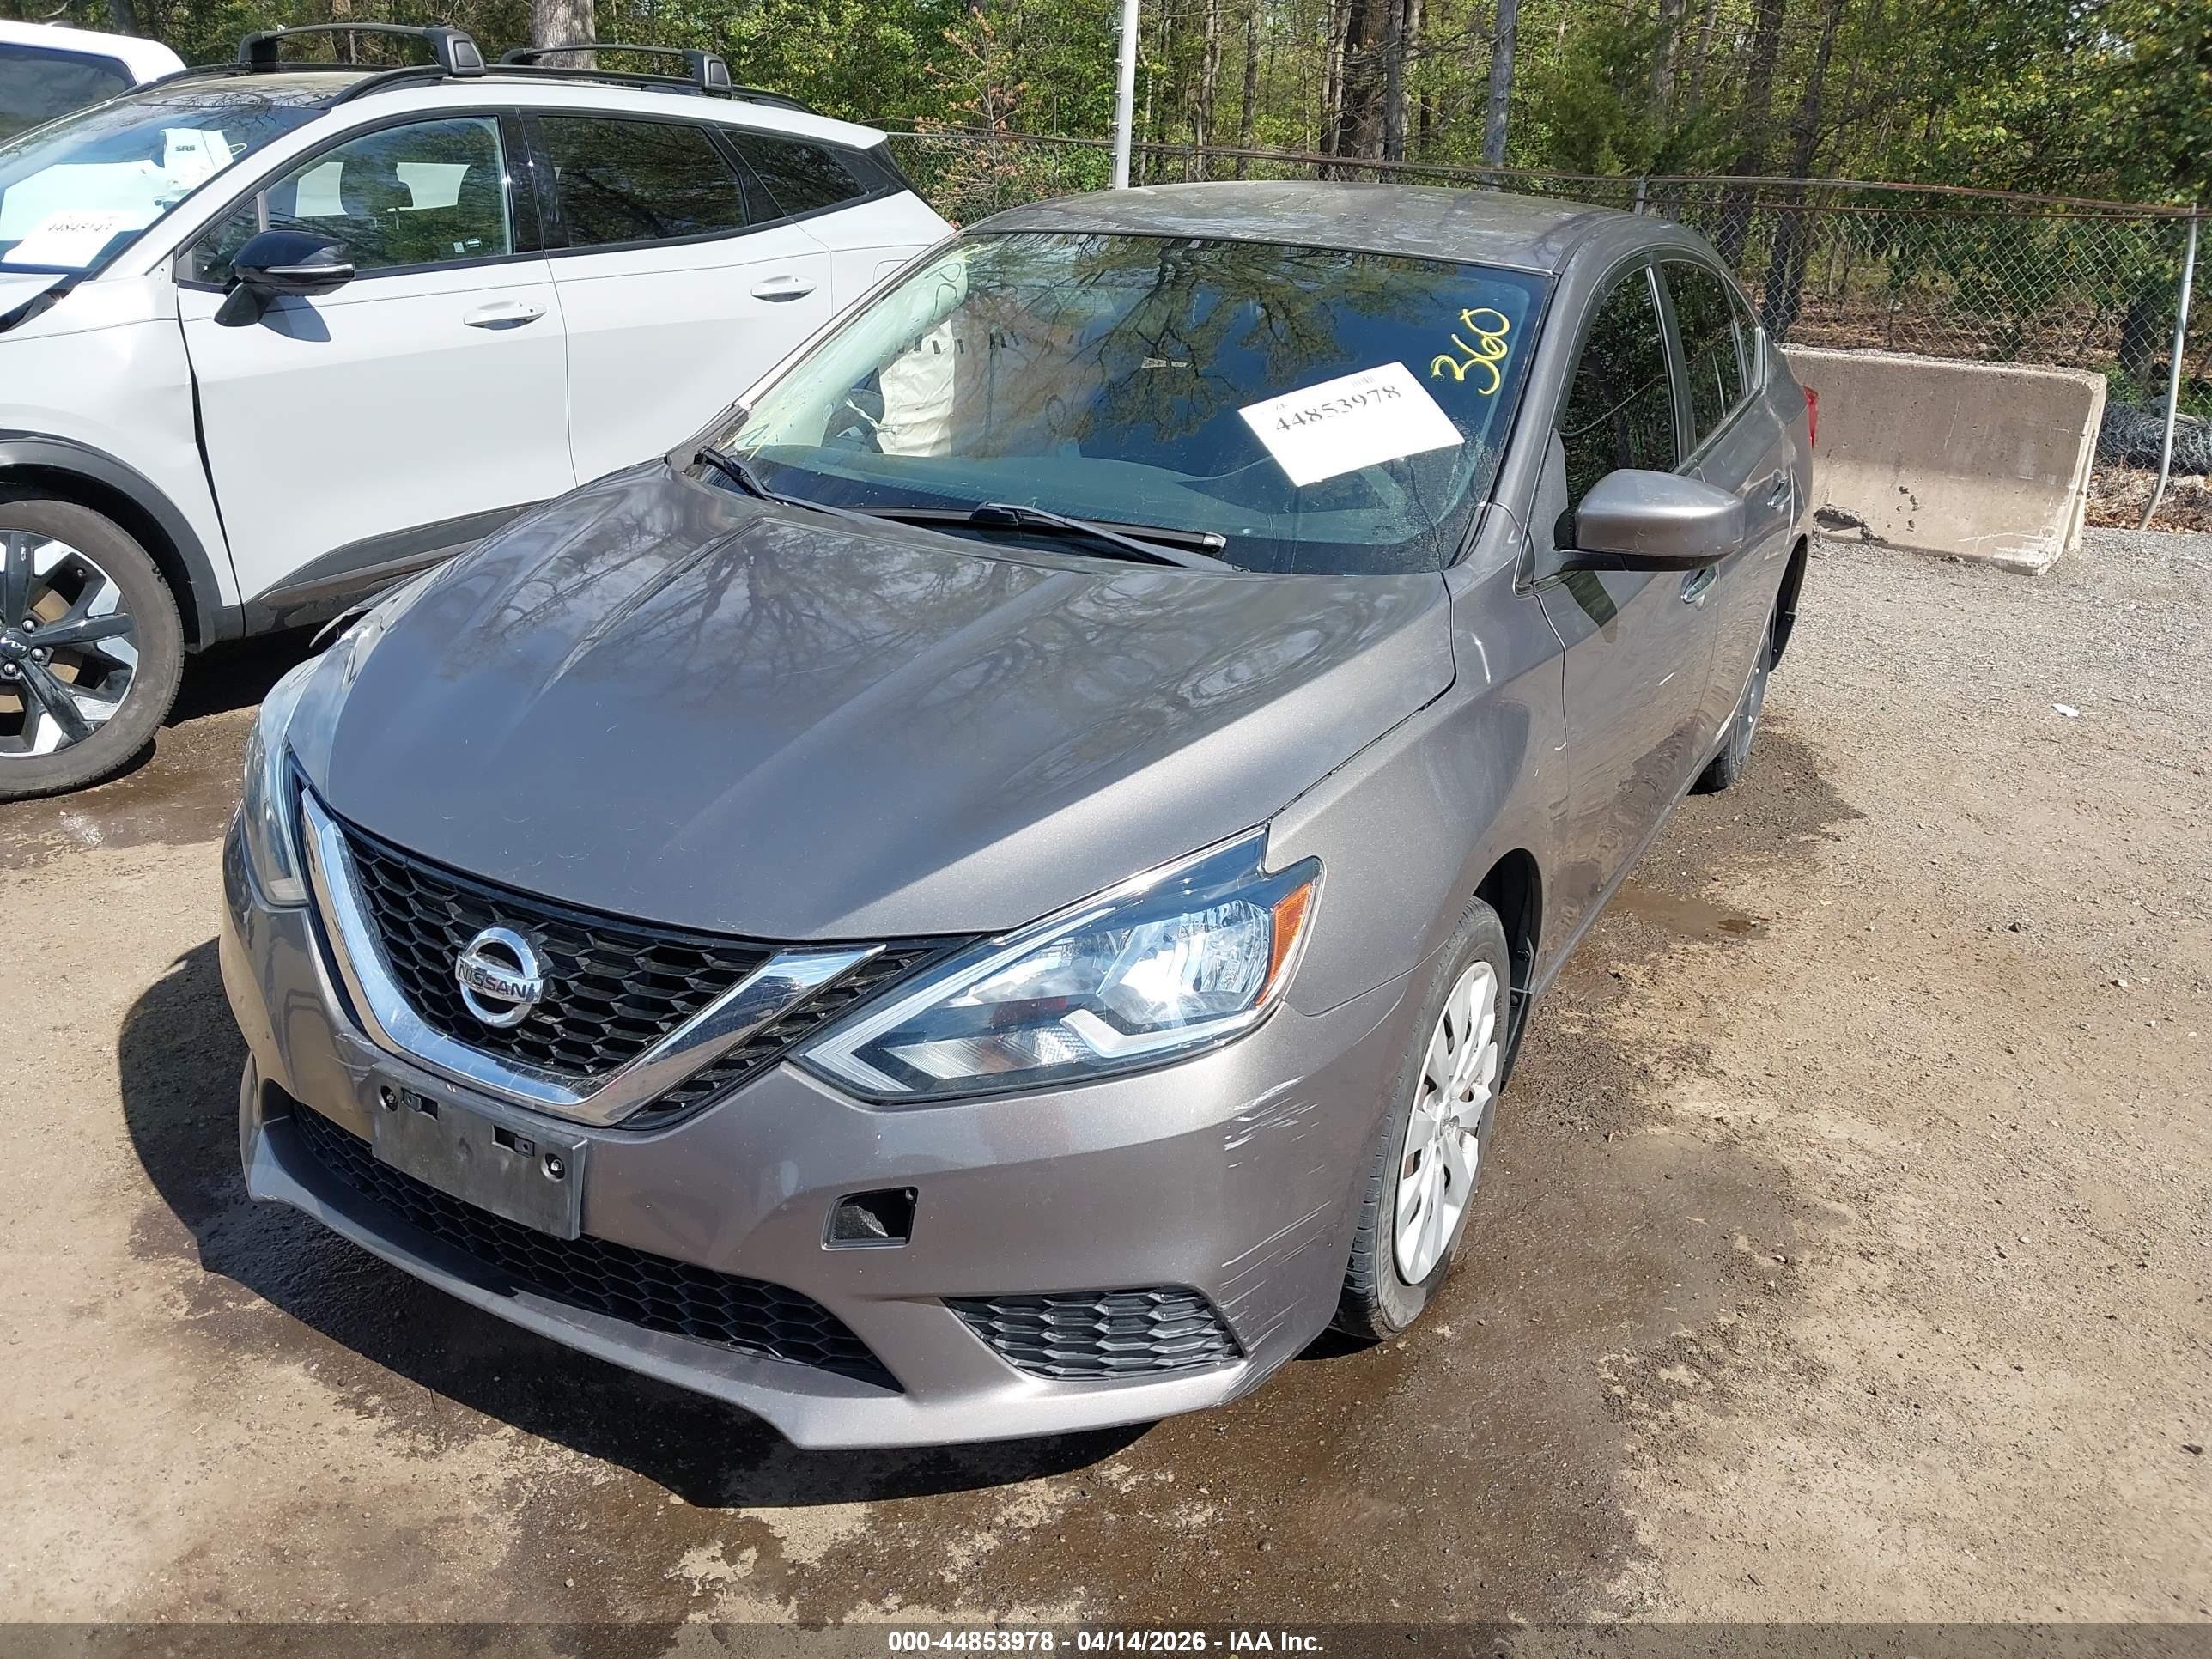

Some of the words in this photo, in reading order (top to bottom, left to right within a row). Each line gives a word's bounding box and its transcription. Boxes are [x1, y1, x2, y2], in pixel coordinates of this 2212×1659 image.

[1430, 307, 1510, 395] 360
[1275, 384, 1401, 431] 44853978
[458, 962, 527, 999] NISSAN
